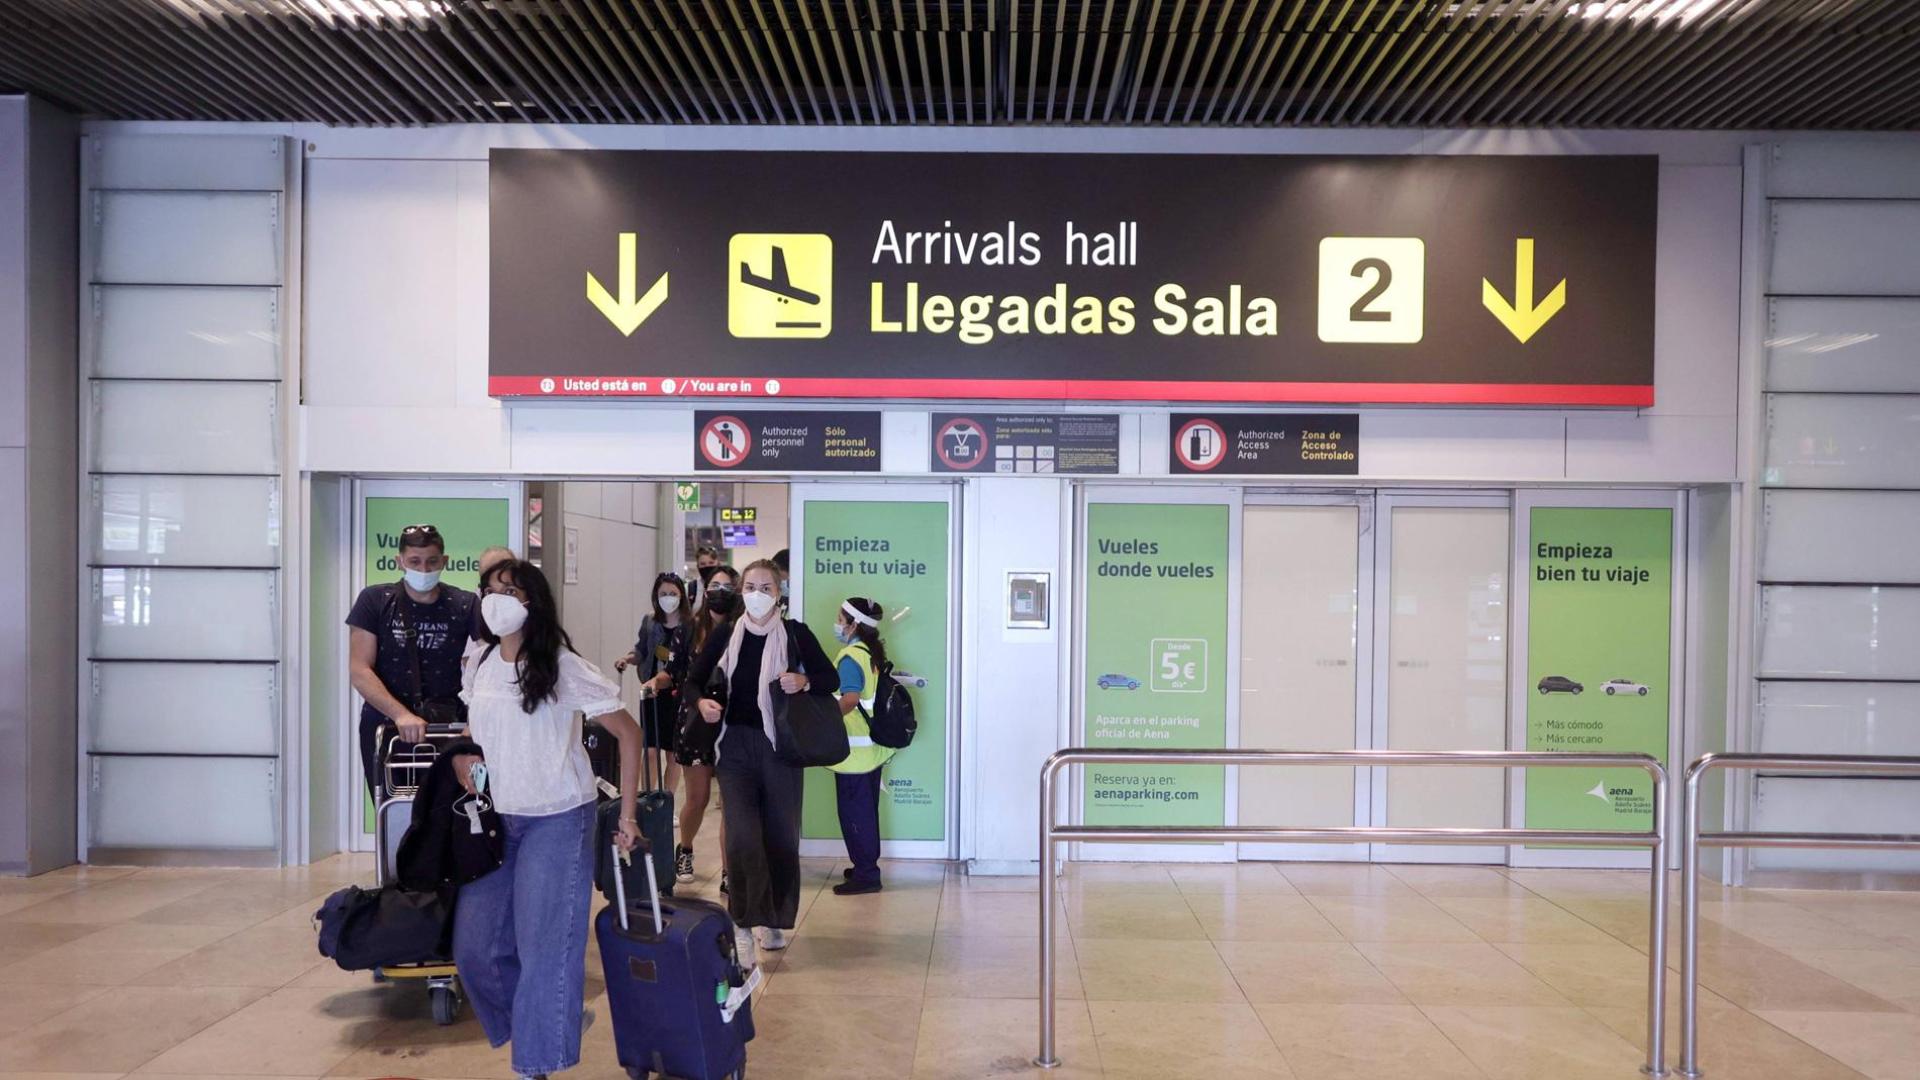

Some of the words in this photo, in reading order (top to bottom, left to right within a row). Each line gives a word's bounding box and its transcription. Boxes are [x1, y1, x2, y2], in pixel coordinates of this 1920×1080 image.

[872, 219, 1042, 266] Arrivals
[1065, 221, 1138, 266] hall
[1348, 257, 1394, 323] 2
[870, 282, 1136, 346] Llegadas
[1152, 283, 1279, 337] Sala
[563, 379, 600, 391] Usted
[602, 379, 628, 391] está
[631, 382, 647, 391] en
[690, 380, 715, 392] You
[716, 383, 737, 392] are
[740, 380, 751, 392] in
[761, 426, 808, 436] Authorized
[825, 426, 847, 436] Sólo
[1237, 430, 1285, 440] Authorized
[1301, 431, 1325, 440] Zona
[1329, 430, 1341, 440] de
[761, 437, 805, 447] personnel
[825, 437, 867, 447] personal
[1237, 440, 1270, 450] Access
[1301, 441, 1337, 450] Acceso
[761, 448, 780, 458] only
[825, 448, 876, 457] autorizado
[1237, 450, 1258, 460] Area
[1301, 450, 1355, 460] Controlado
[744, 509, 755, 519] 12
[815, 536, 890, 555] Empieza
[1098, 538, 1159, 555] Vueles
[1537, 542, 1613, 561] Empieza
[444, 556, 480, 572] uele
[815, 558, 853, 574] bien
[859, 560, 878, 574] tu
[884, 559, 927, 578] viaje
[1097, 561, 1152, 577] donde
[1157, 562, 1214, 578] vueles
[1536, 565, 1575, 581] bien
[1581, 566, 1600, 582] tu
[1606, 566, 1650, 586] viaje
[418, 622, 449, 631] JEANS
[1095, 714, 1132, 726] Aparca
[1133, 717, 1146, 725] en
[1149, 715, 1158, 725] el
[1161, 715, 1200, 728] parking
[1546, 719, 1565, 730] Más
[1567, 720, 1604, 730] cómodo
[1095, 728, 1126, 738] oficial
[1128, 728, 1141, 738] de
[1143, 729, 1170, 739] Aena
[1546, 733, 1565, 744] Más
[1567, 735, 1604, 744] cercano
[888, 778, 912, 787] aena
[1094, 773, 1140, 785] Reserva
[1142, 776, 1156, 787] ya
[1158, 776, 1176, 785] en:
[1094, 788, 1199, 802] aenaparking.com
[1609, 788, 1633, 796] aena
